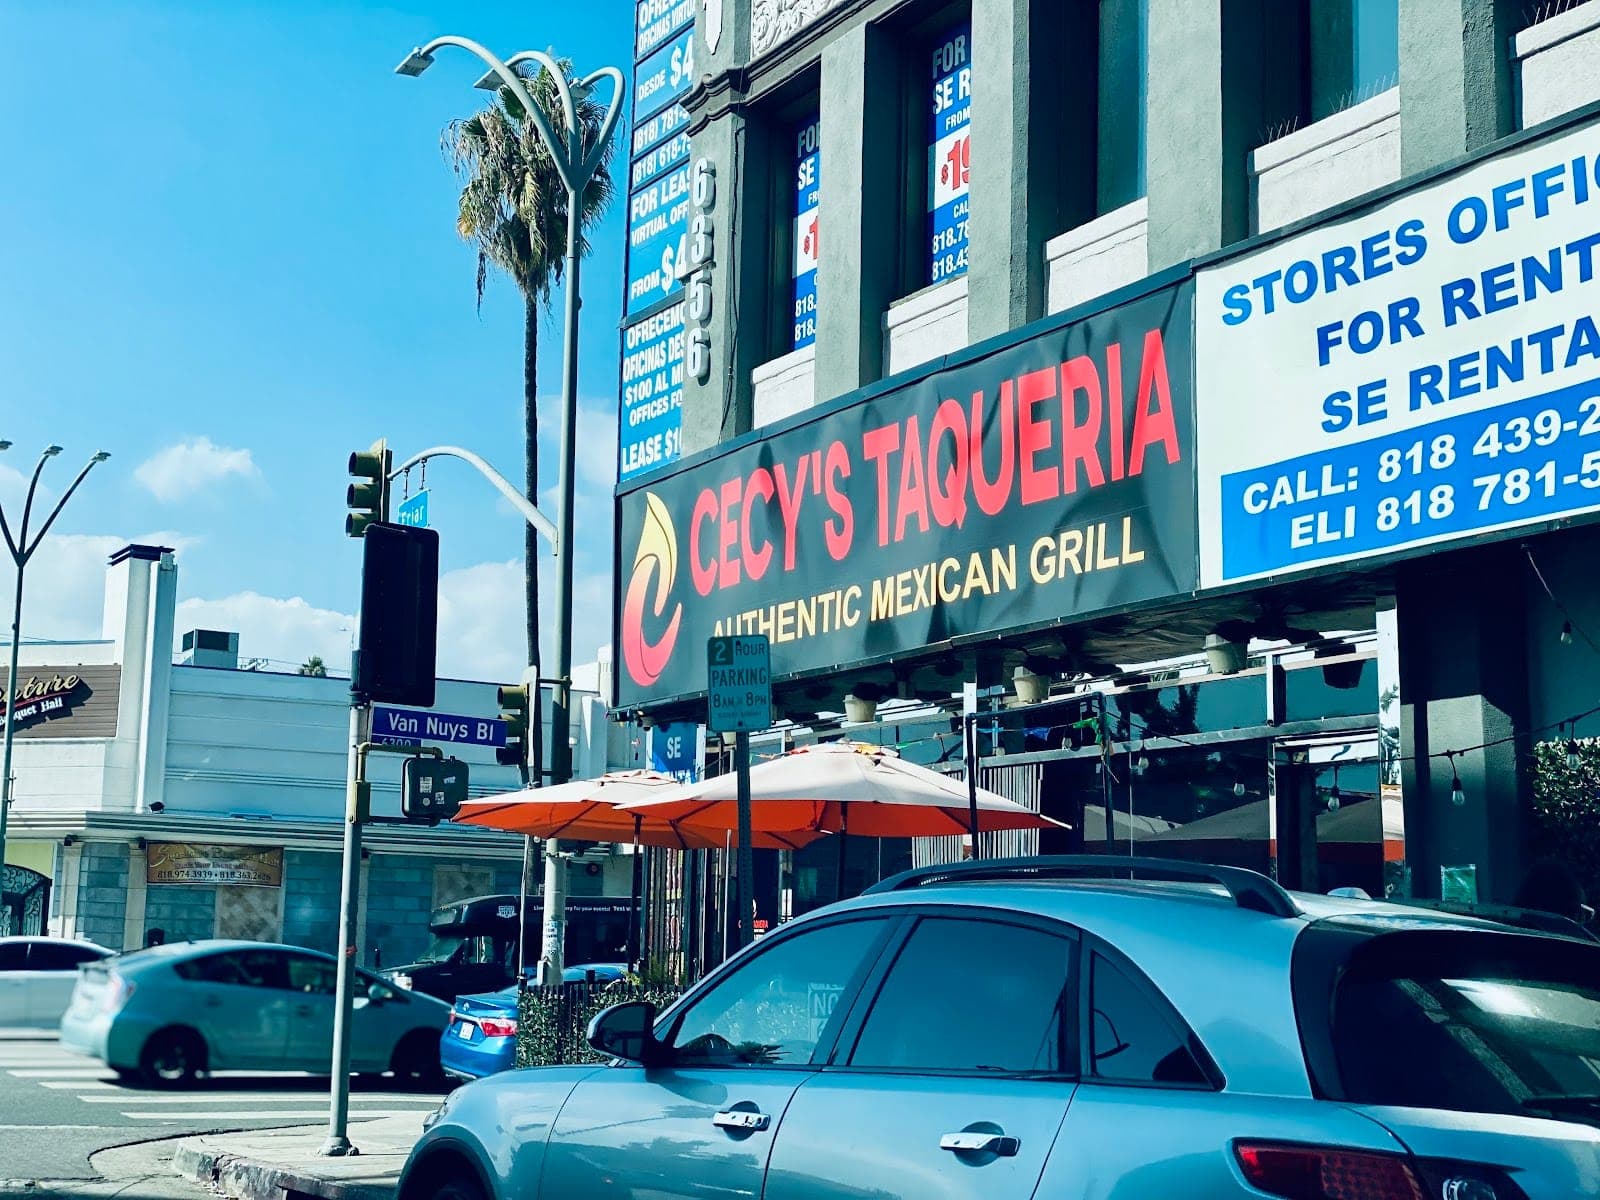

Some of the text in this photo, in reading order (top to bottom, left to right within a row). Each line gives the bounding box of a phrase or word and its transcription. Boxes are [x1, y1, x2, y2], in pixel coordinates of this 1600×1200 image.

[639, 0, 678, 29] OFRE
[932, 35, 966, 79] FOR
[638, 69, 666, 101] DESDE
[932, 76, 954, 115] SE
[945, 106, 971, 131] FROM
[633, 119, 658, 156] (818)
[632, 152, 657, 189] (818)
[798, 157, 815, 191] SE
[631, 187, 658, 223] FOR
[808, 190, 820, 205] FR
[631, 212, 668, 247] VIRTUAL
[1222, 153, 1600, 327] STORES OFFI
[631, 269, 661, 300] FROM
[1316, 232, 1600, 367] FOR RENT
[622, 340, 667, 383] OFICINAS
[1321, 315, 1600, 433] SE RENTA
[625, 361, 683, 408] $100 AL M
[629, 395, 669, 427] OFFICES
[622, 433, 662, 474] LEASE
[690, 328, 1181, 596] CECY'S TAQUERIA
[1242, 396, 1600, 514] CALL: 818 439-2
[1290, 450, 1600, 549] ELI 818 781-5
[870, 544, 1017, 622] MEXICAN
[1030, 516, 1145, 585] GRILL
[714, 641, 766, 662] 2 HOUR
[711, 667, 767, 687] PARKING
[40, 697, 63, 713] Hall
[388, 712, 418, 734] Van
[426, 717, 469, 741] Nuys
[667, 736, 682, 759] SE
